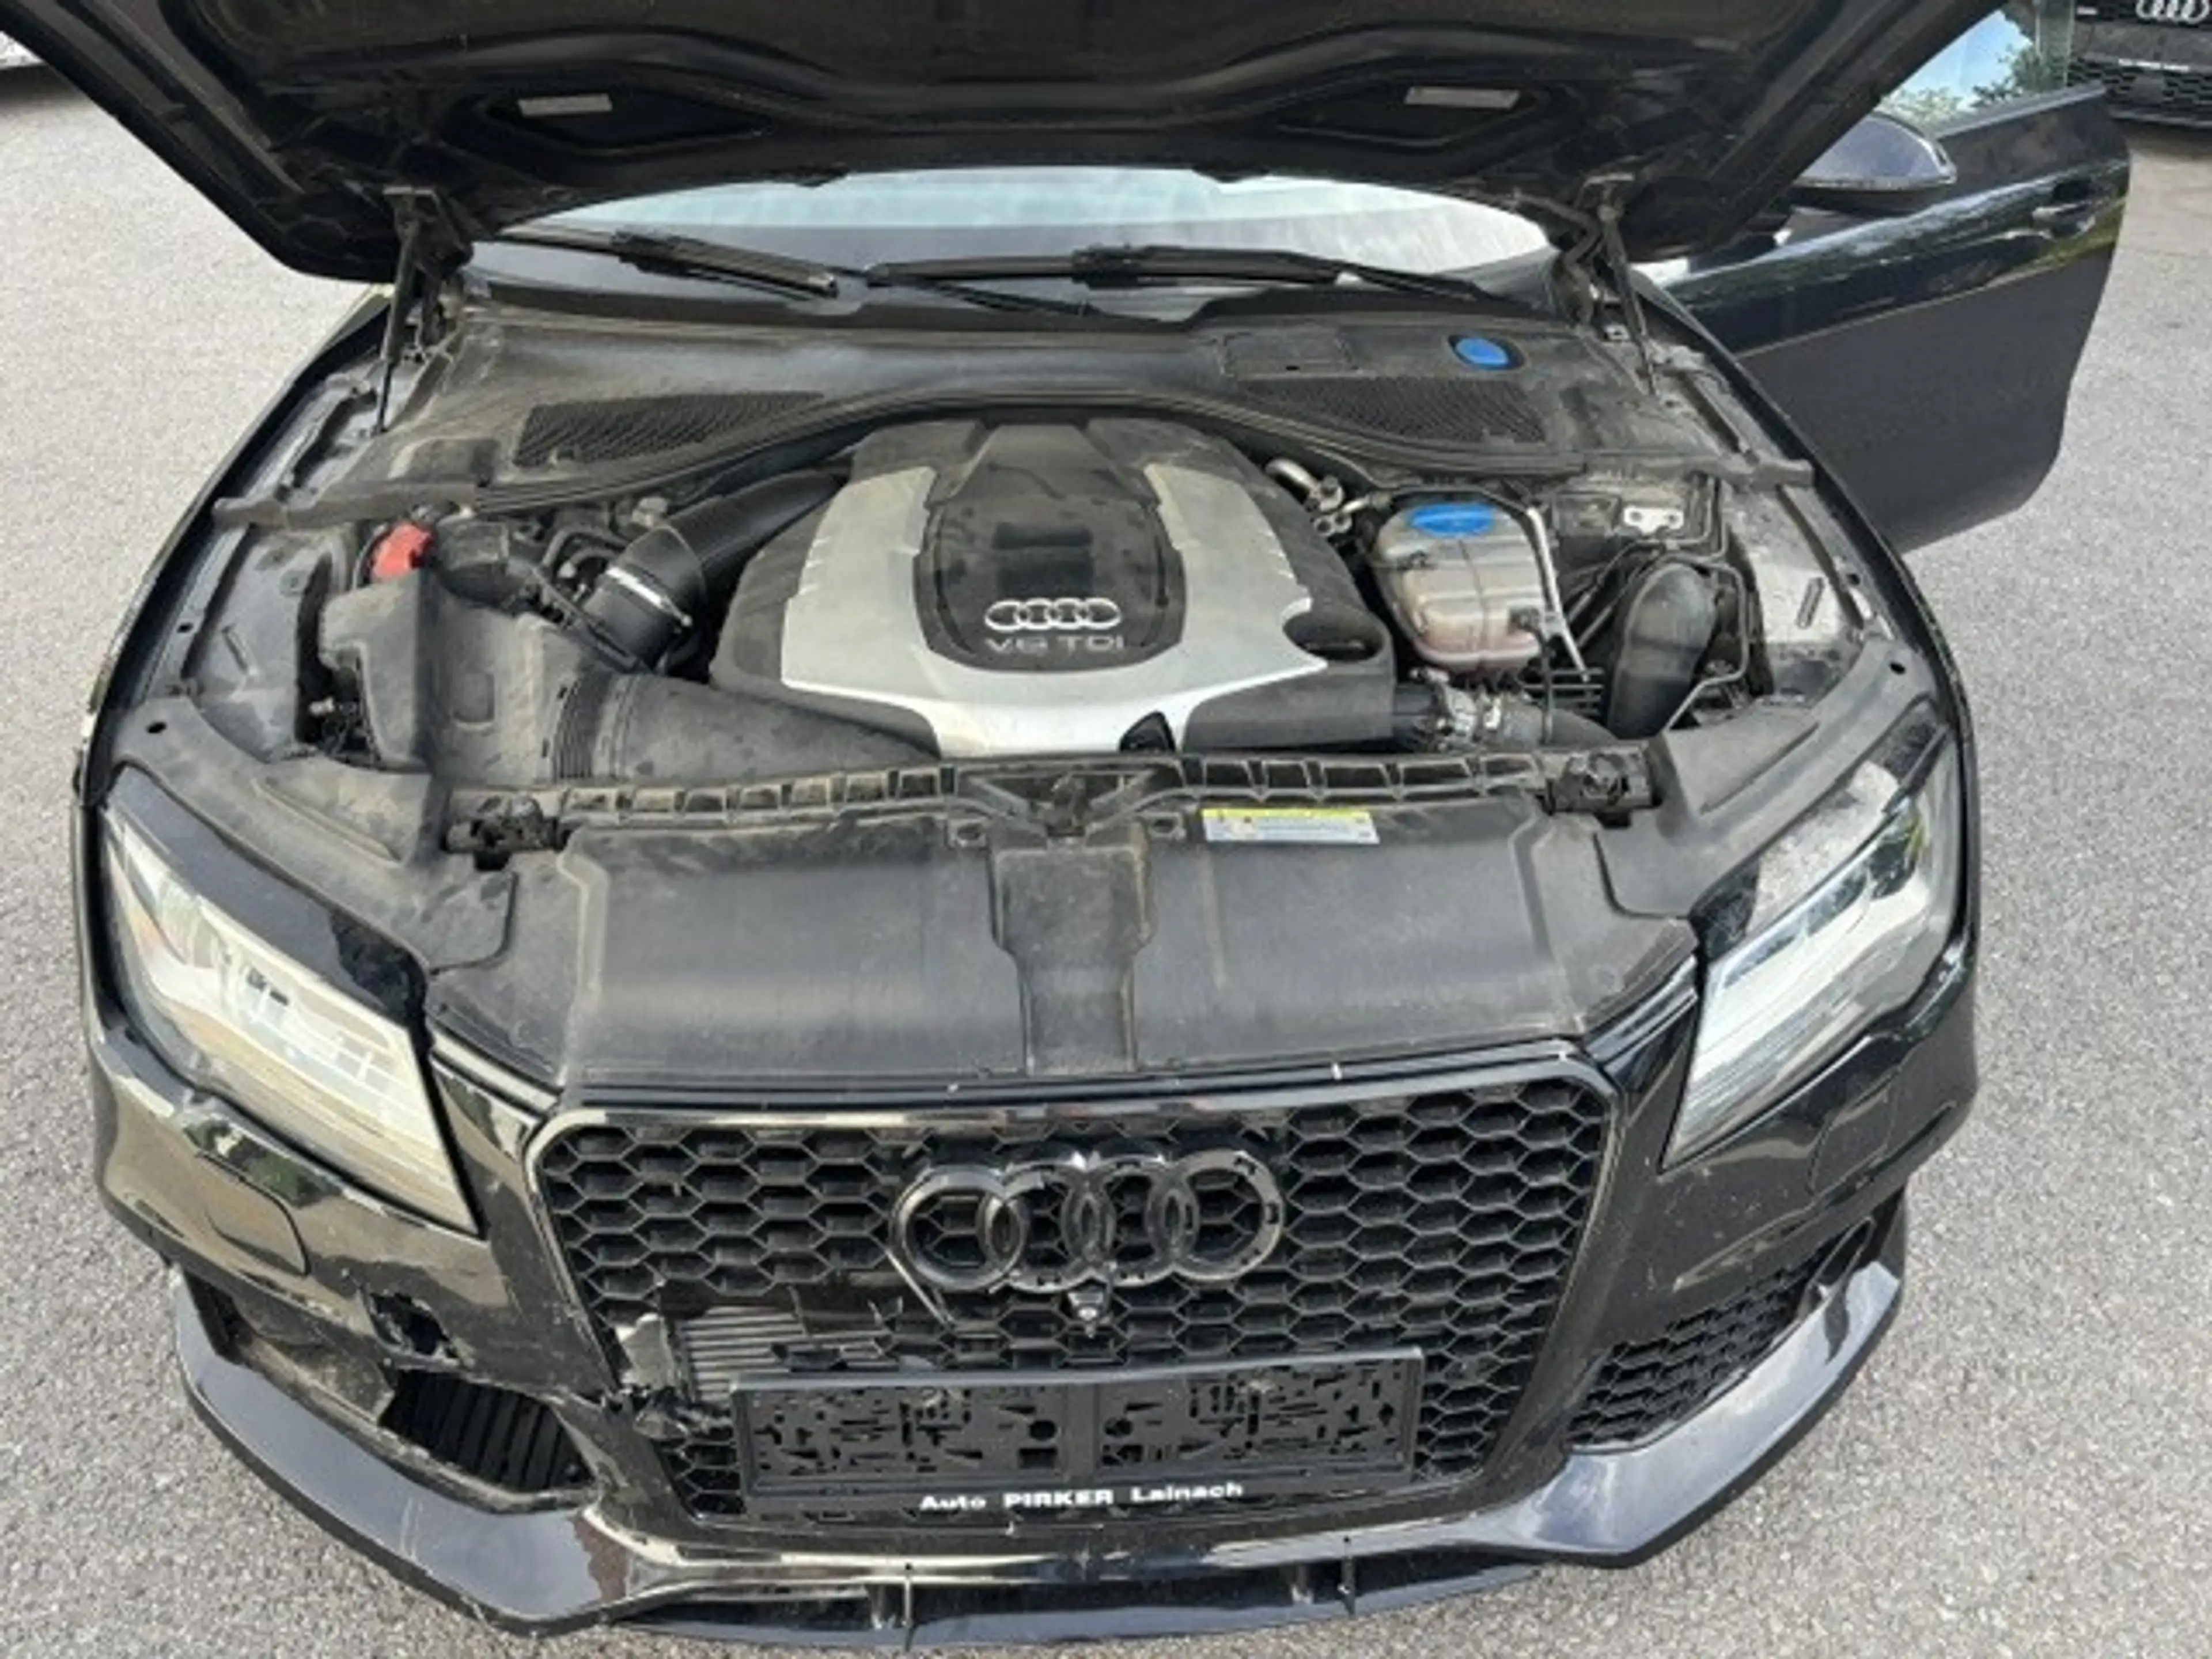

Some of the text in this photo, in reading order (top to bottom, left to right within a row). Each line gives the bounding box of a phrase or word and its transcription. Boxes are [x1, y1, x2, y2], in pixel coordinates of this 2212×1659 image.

[985, 634, 1126, 656] V6 TDI
[920, 1494, 987, 1512] Auto
[1003, 1488, 1115, 1509] PIRKER
